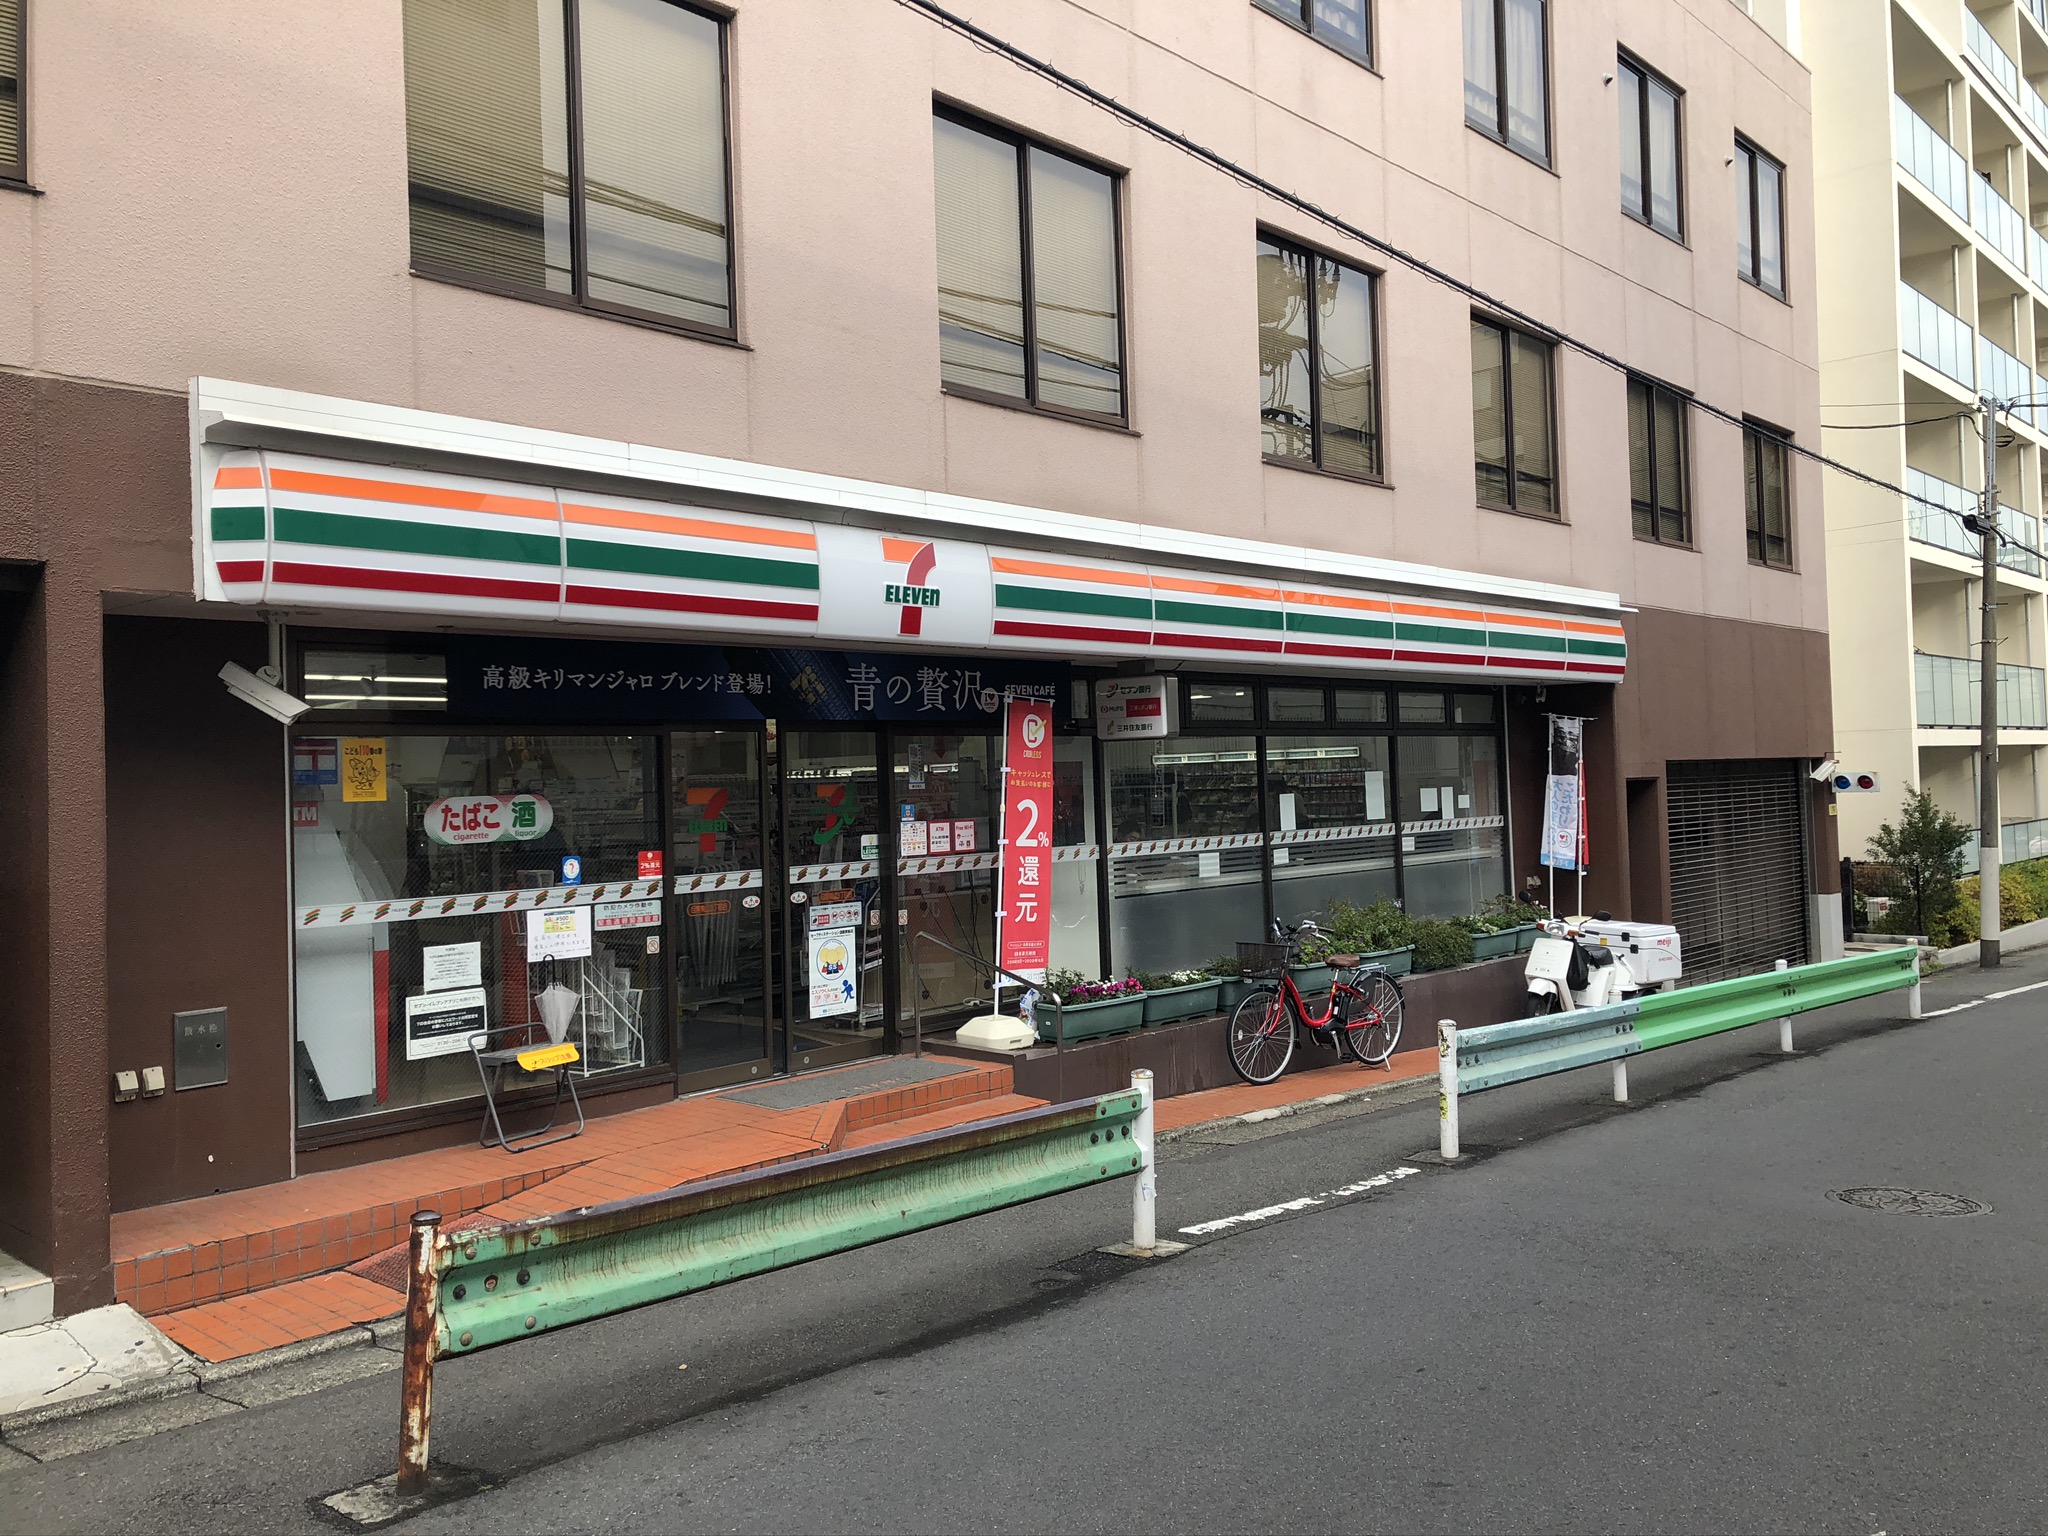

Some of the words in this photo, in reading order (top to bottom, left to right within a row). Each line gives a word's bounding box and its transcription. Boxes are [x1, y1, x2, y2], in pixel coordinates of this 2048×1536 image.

[482, 665, 653, 690] 高級キリマンジャロ
[660, 672, 772, 694] ブレンド登場!
[845, 662, 983, 712] 青の贅沢
[1004, 685, 1033, 696] SEVEN
[1033, 682, 1056, 696] CAFÉ
[1120, 685, 1151, 694] セブン銀行
[1117, 723, 1153, 732] 三井住友銀行
[1010, 768, 1051, 779] キャッシュレスで
[293, 806, 318, 821] TM
[441, 802, 500, 832] たばこ
[511, 801, 537, 829] 酒
[453, 831, 490, 842] cigarette
[514, 829, 538, 838] liquor
[1015, 855, 1040, 923] 還元
[603, 901, 654, 911] 防犯カメラ作動中
[1657, 938, 1672, 947] meiji
